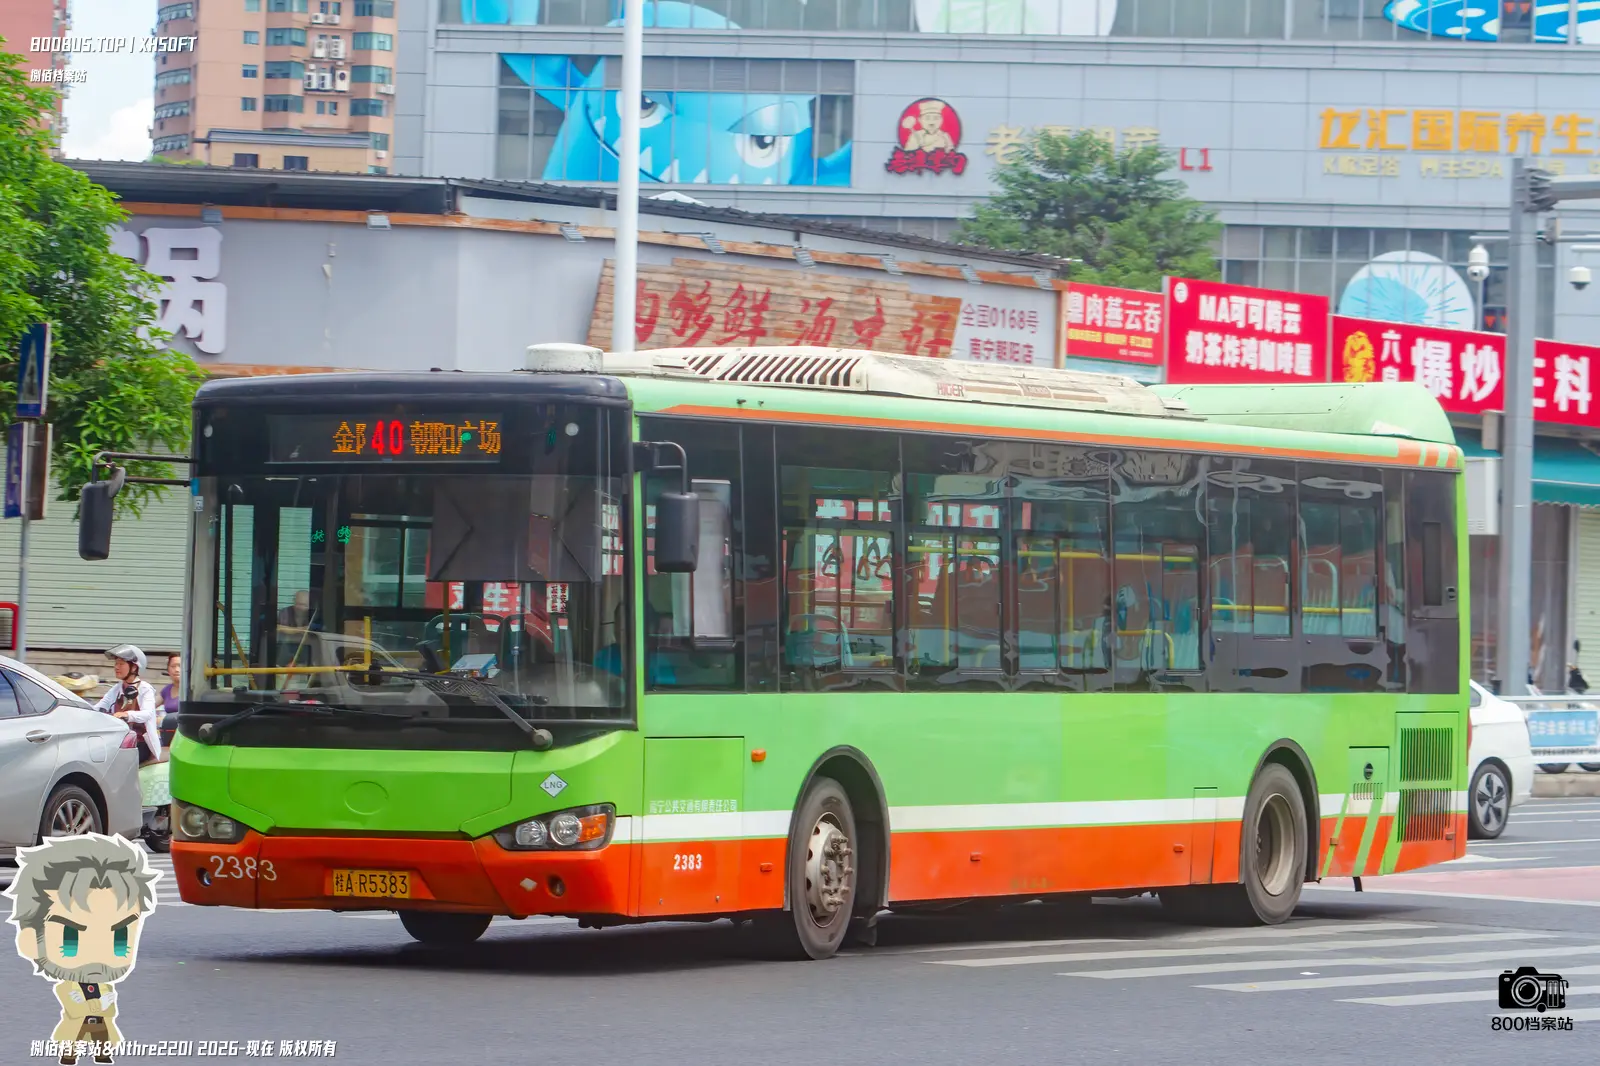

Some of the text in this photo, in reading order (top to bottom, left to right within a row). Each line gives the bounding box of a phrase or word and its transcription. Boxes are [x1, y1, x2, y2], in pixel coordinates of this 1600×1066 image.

[1318, 107, 1600, 154] 龙汇国际养生
[1180, 147, 1213, 171] L1
[961, 303, 1040, 333] 全国0168号
[371, 420, 404, 455] 40
[409, 420, 501, 455] 朝阳广场
[544, 781, 563, 789] LNG
[210, 855, 277, 881] 2383
[673, 853, 702, 871] 2383
